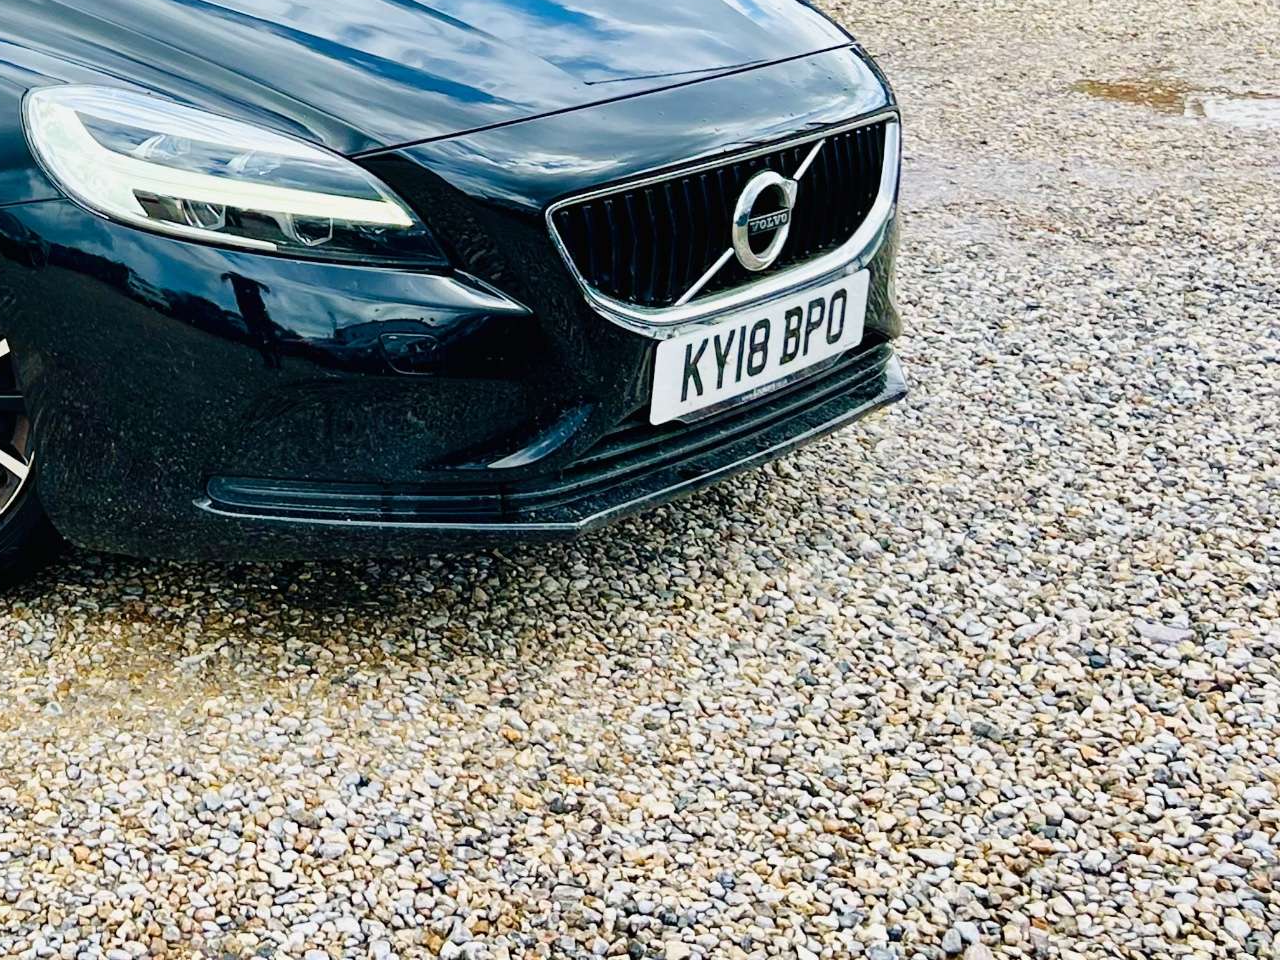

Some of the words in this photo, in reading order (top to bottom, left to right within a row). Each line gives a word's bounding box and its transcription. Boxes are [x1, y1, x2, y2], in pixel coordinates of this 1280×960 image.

[750, 213, 788, 232] VOLVO
[680, 317, 771, 403] KY18
[780, 288, 848, 367] BPO
